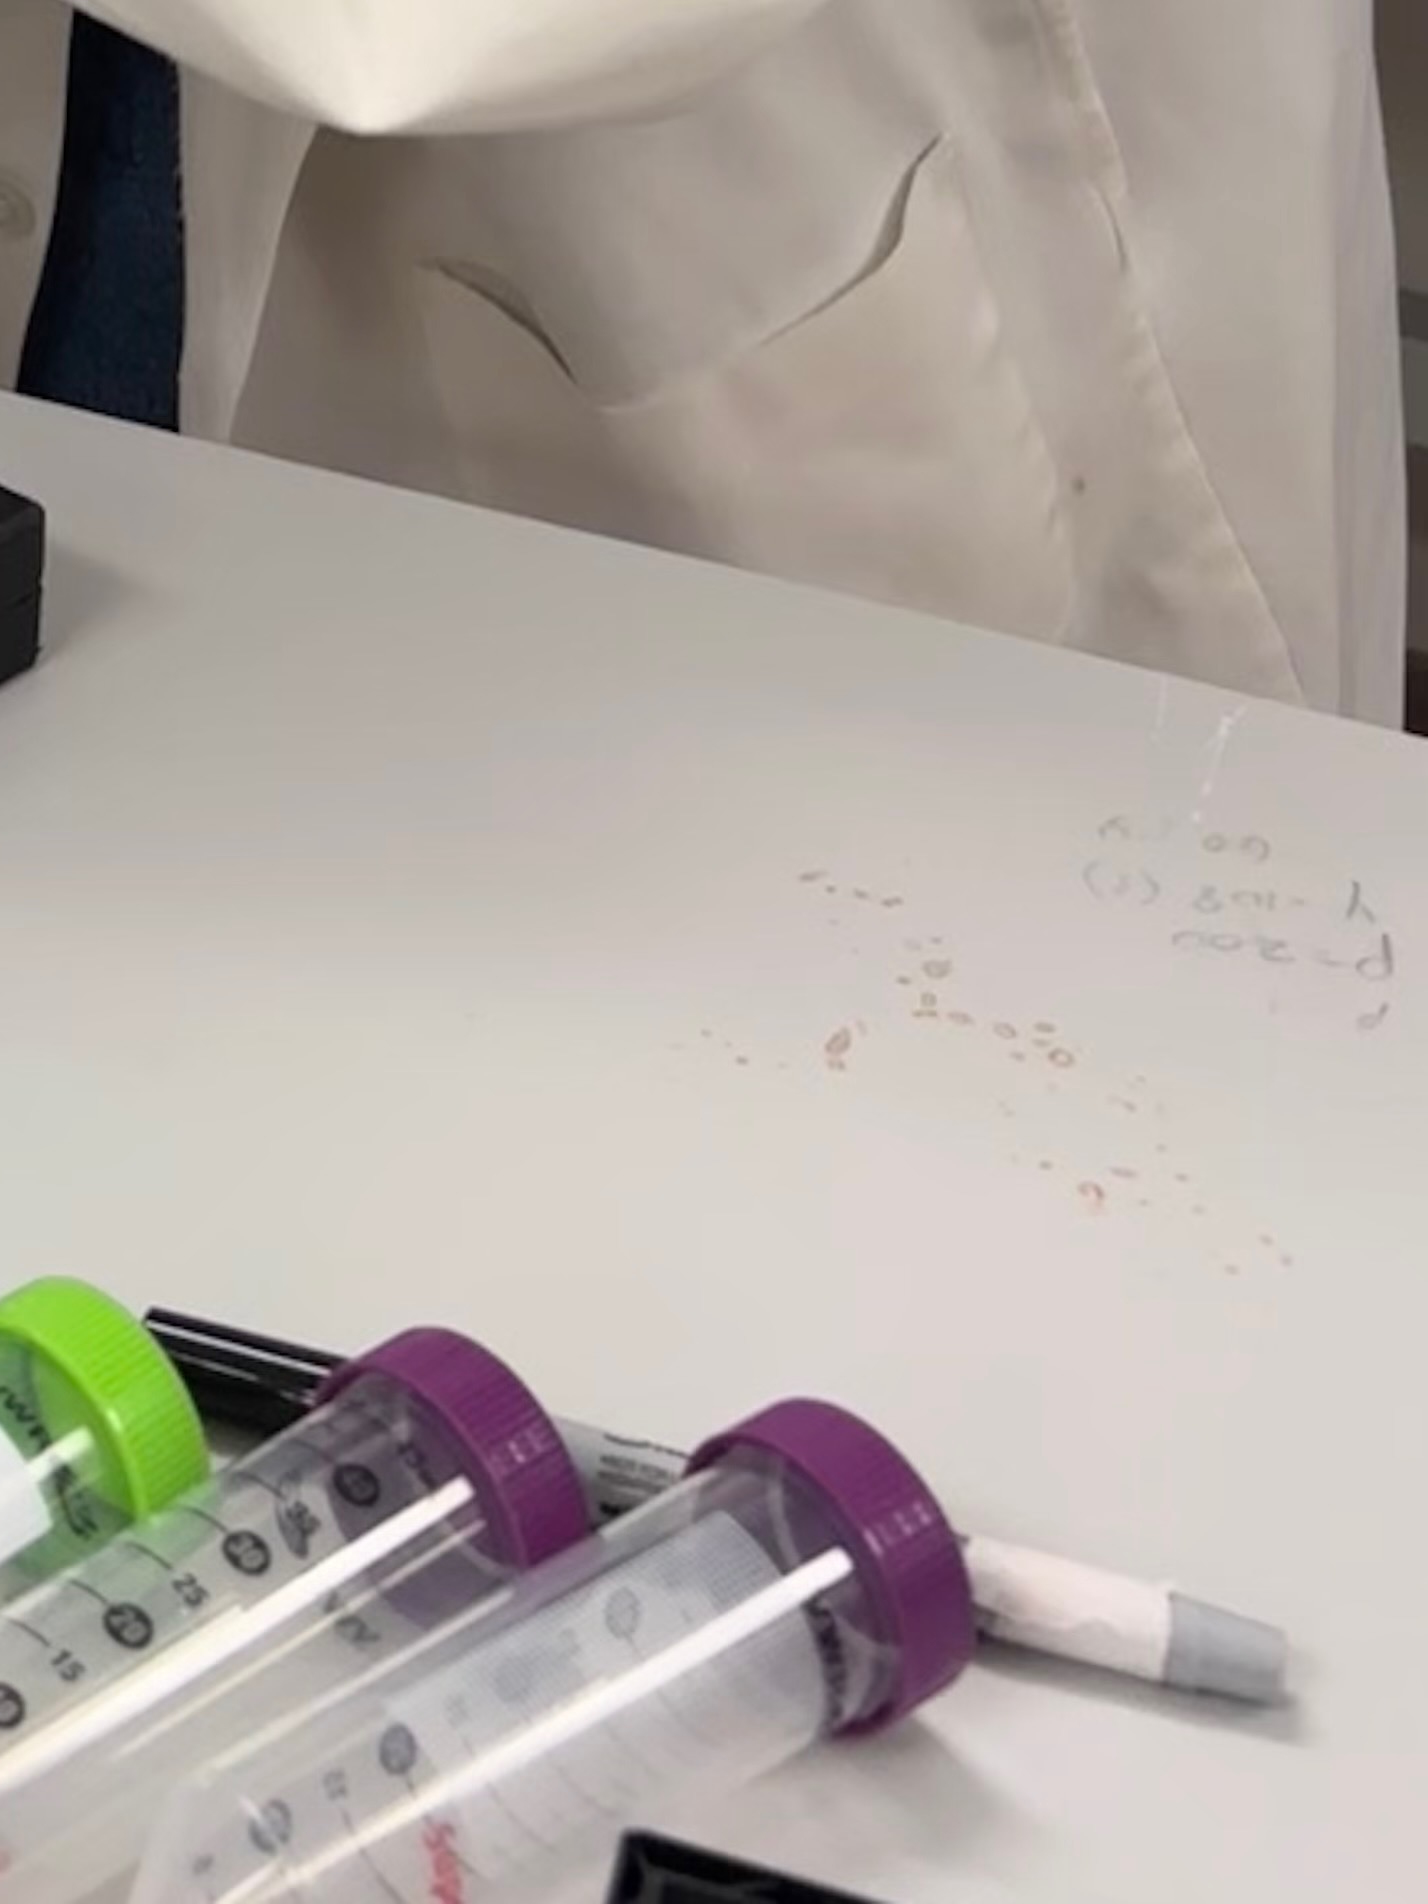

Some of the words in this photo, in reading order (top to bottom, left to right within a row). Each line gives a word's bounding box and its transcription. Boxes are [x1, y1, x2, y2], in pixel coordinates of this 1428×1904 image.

[170, 1572, 211, 1609] 25
[107, 1605, 151, 1647] 20
[49, 1648, 87, 1684] 15
